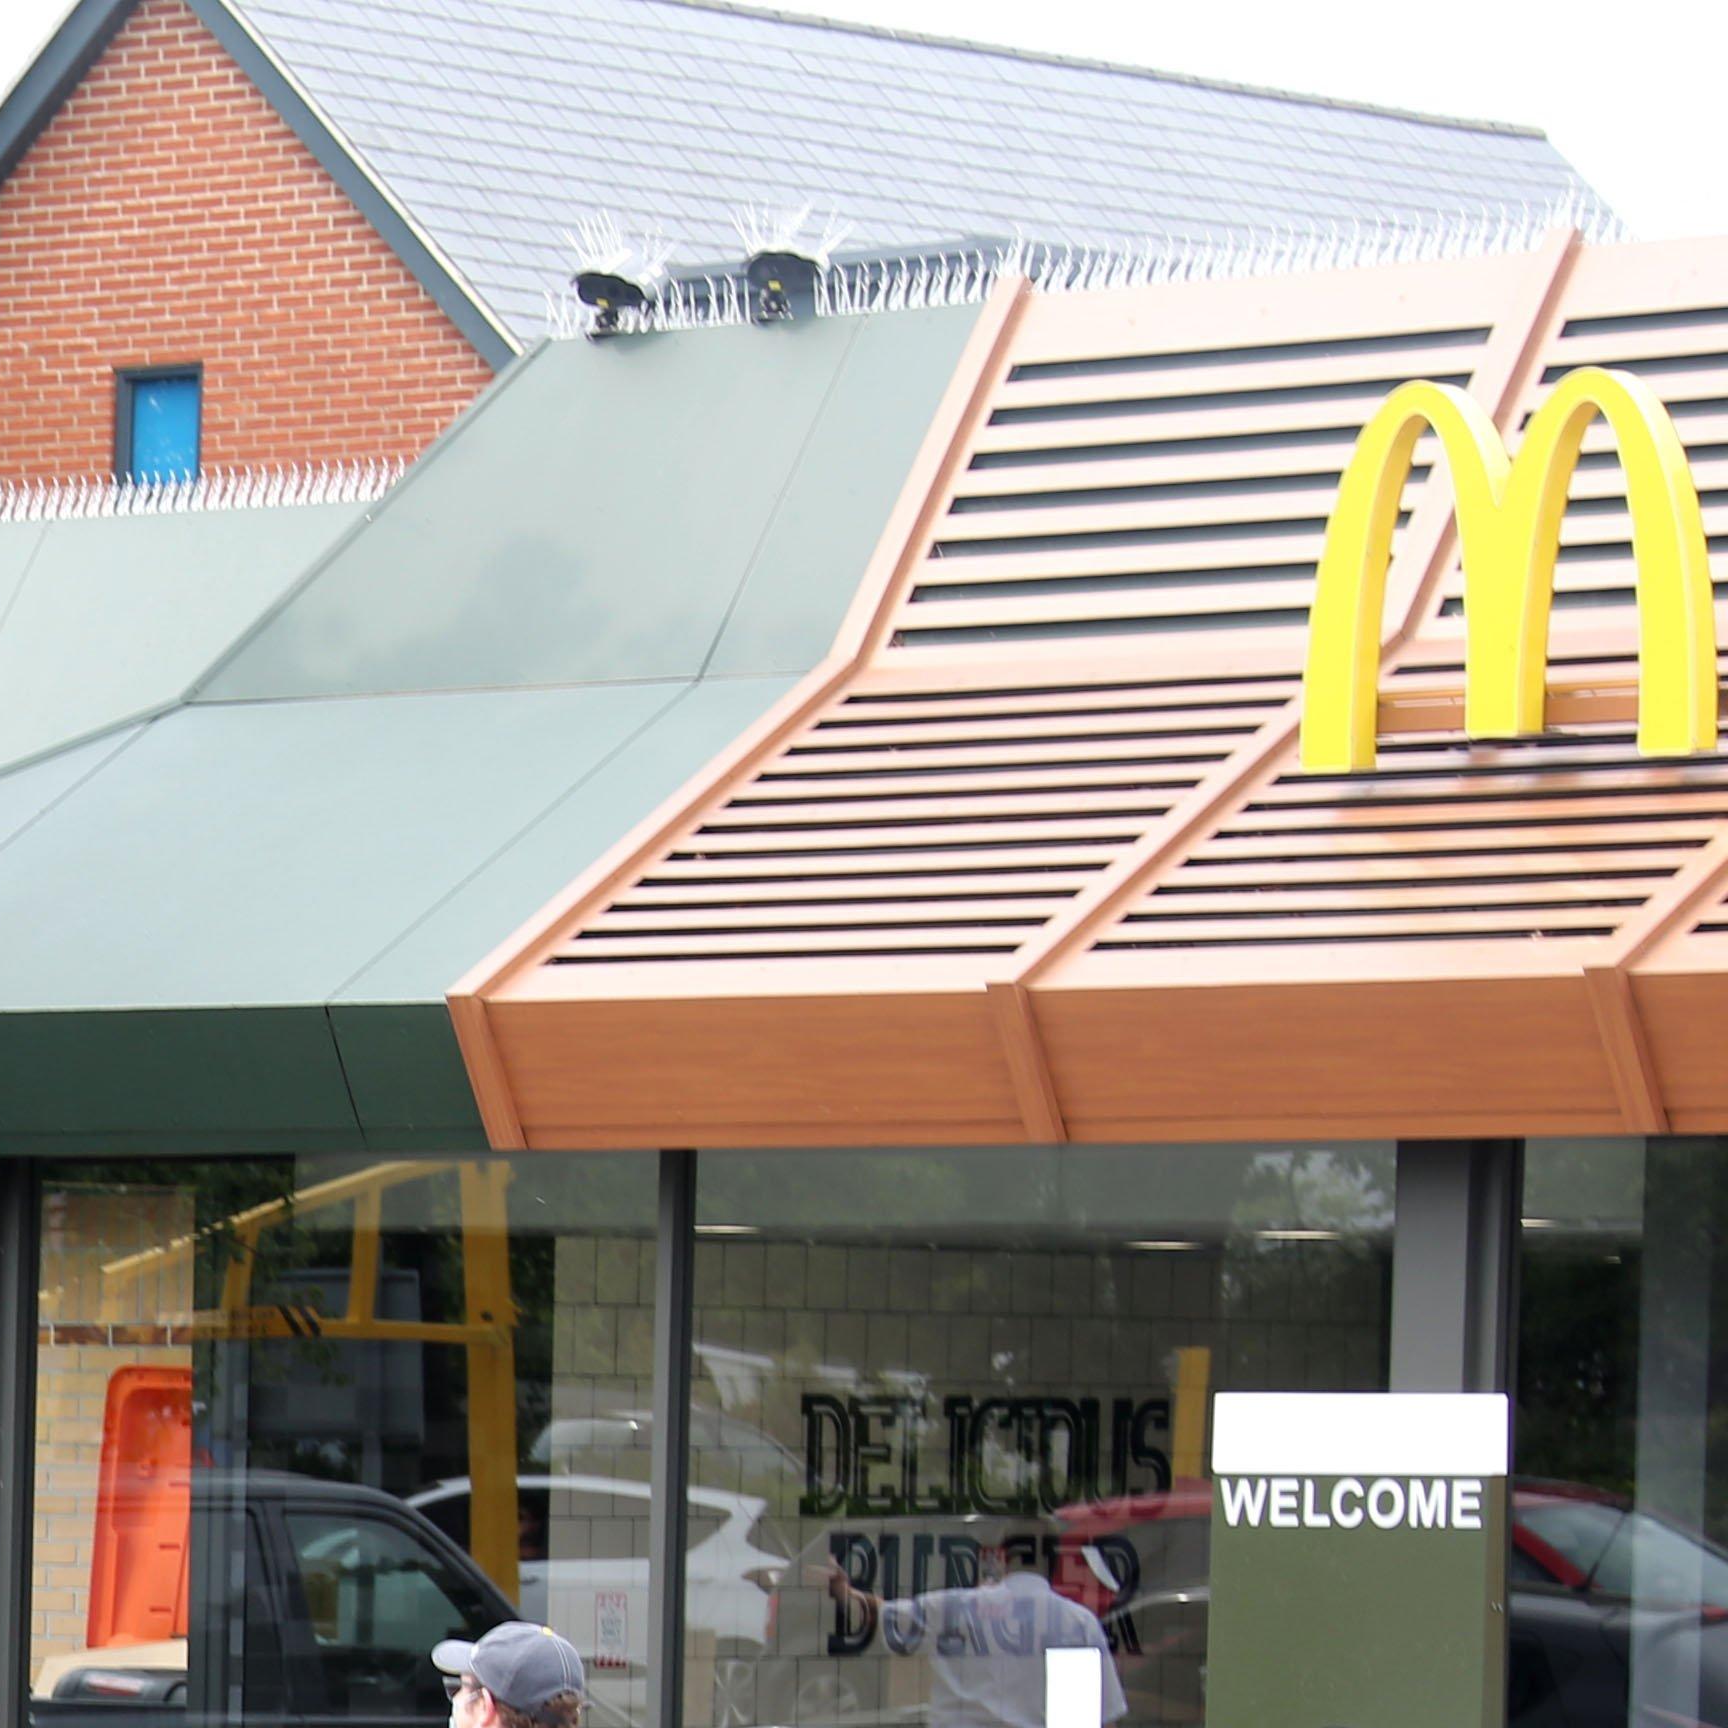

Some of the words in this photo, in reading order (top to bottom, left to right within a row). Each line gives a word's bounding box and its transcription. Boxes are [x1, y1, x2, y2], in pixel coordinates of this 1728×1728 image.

[799, 1394, 1172, 1517] DELICIOUS
[1220, 1476, 1483, 1530] WELCOME
[828, 1532, 1143, 1656] BURGER
